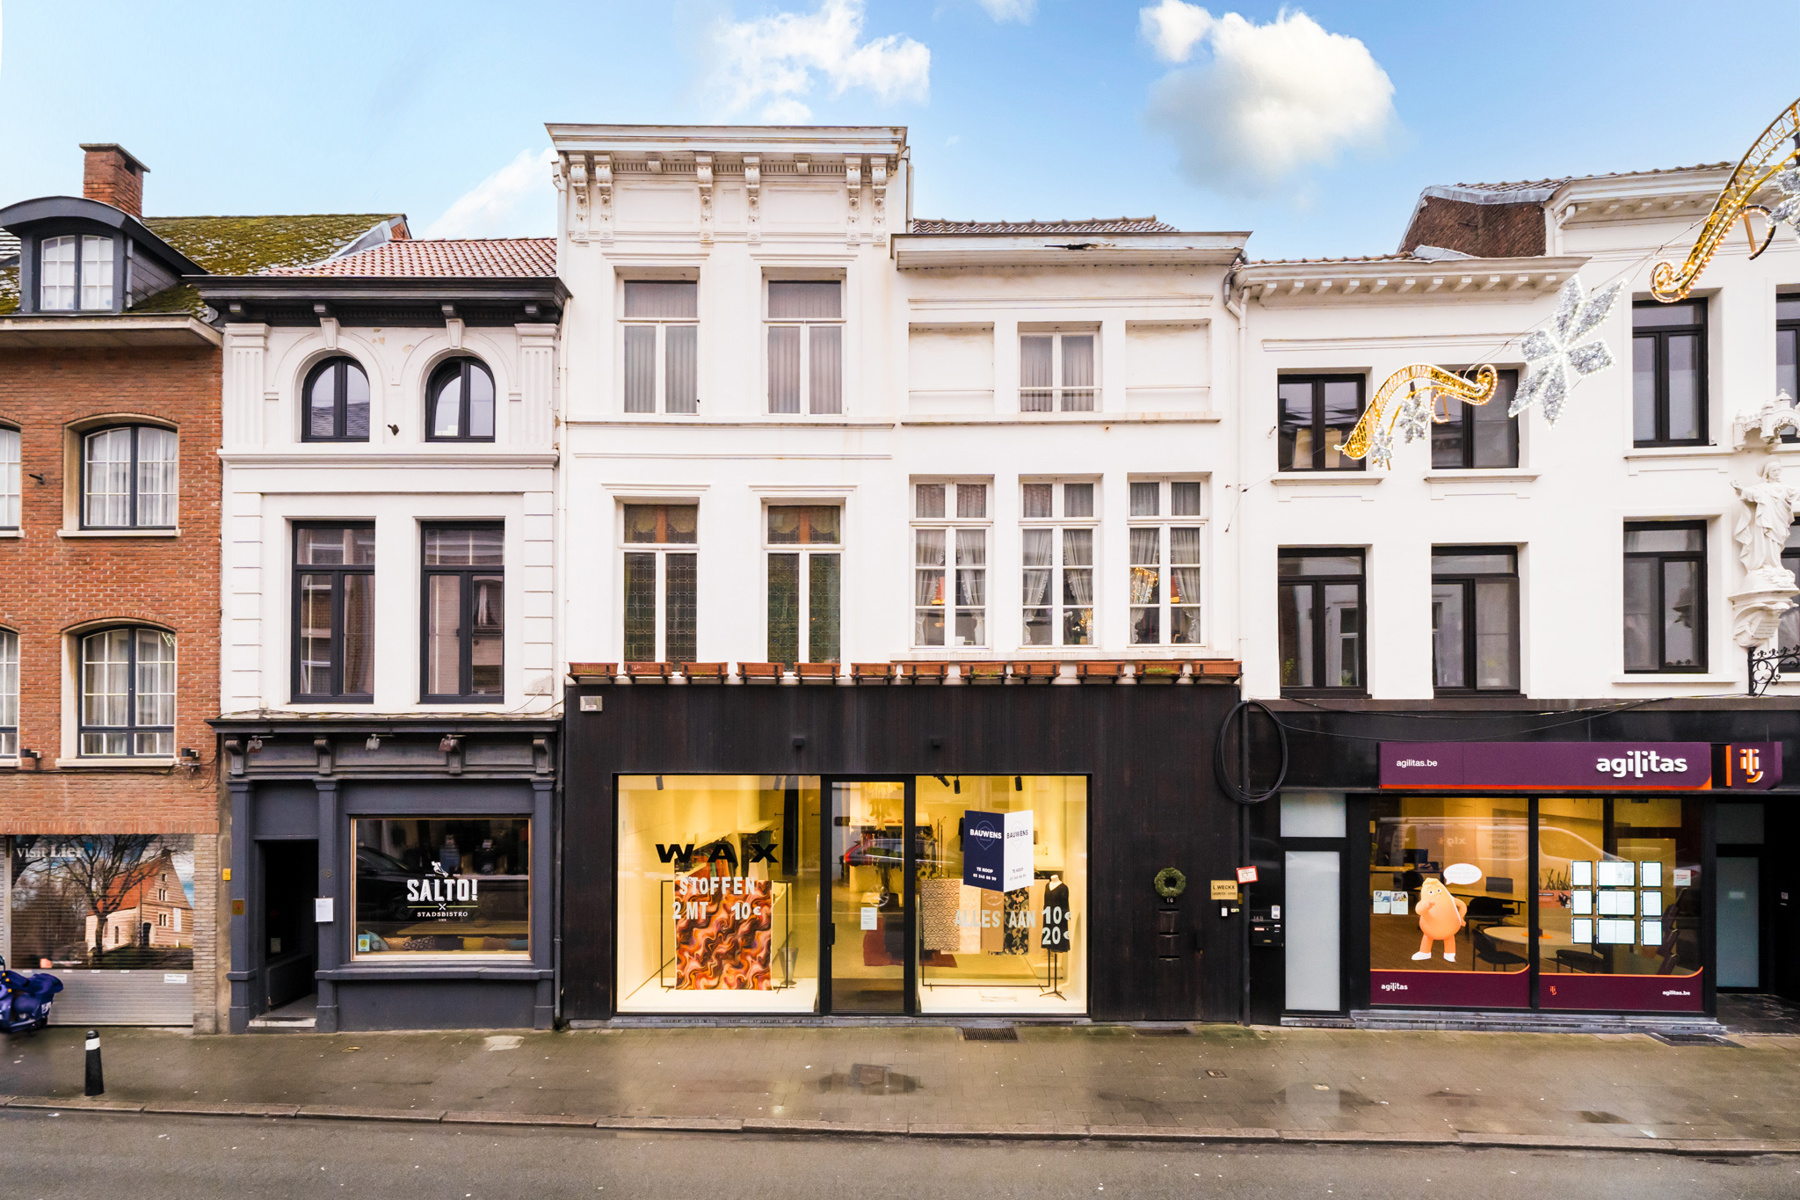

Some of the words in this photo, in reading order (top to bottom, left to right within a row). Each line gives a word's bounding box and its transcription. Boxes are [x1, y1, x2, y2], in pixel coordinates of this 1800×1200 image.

[1396, 759, 1438, 768] agilitas.be
[1596, 751, 1688, 778] agilitas
[969, 828, 1002, 839] BAUWENS
[1006, 829, 1029, 839] BAUWENS
[16, 843, 47, 858] visit
[50, 844, 85, 858] Lier
[655, 844, 779, 863] WAX
[407, 879, 478, 901] SALTO!
[680, 876, 755, 895] STOFFEN
[672, 902, 681, 919] 2
[686, 902, 708, 920] MT
[731, 902, 761, 920] 10€
[954, 909, 1001, 928] ALLES
[1009, 910, 1036, 928] AAN
[1381, 982, 1408, 991] agilitas
